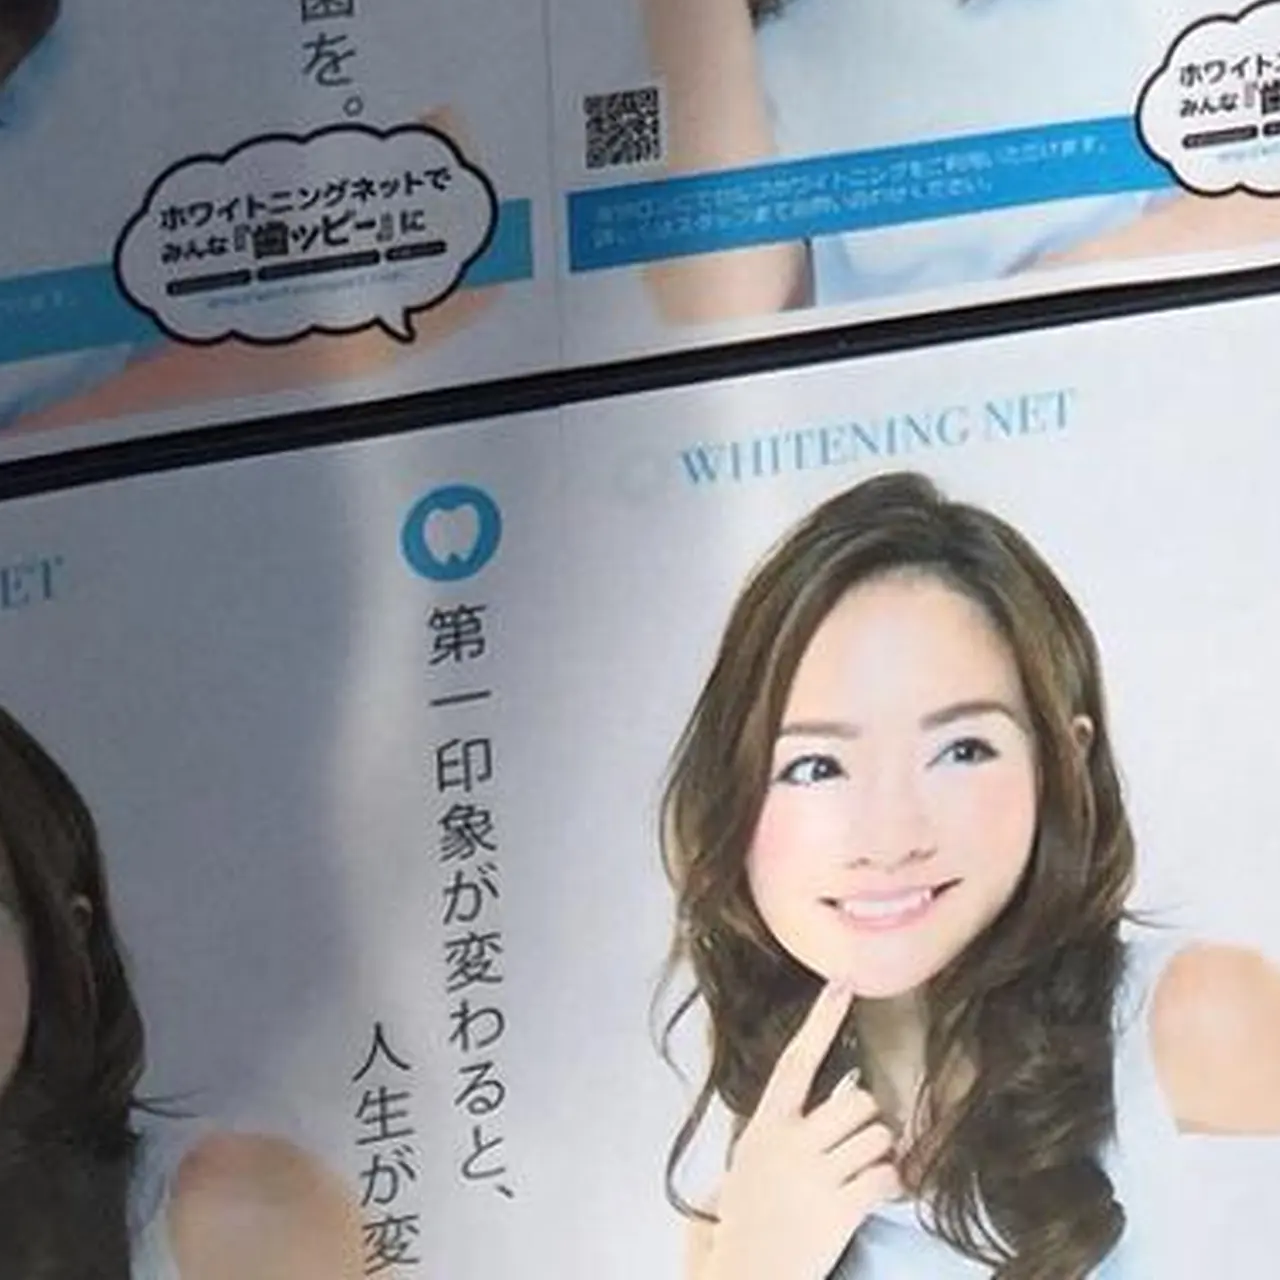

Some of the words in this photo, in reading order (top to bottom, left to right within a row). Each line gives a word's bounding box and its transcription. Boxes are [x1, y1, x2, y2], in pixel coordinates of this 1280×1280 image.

[160, 167, 451, 231] ホワイトニングネットで
[678, 399, 971, 487] WHITENING
[984, 386, 1078, 438] NET
[426, 603, 516, 1200] 第一印象が変わると、
[351, 1020, 421, 1277] 人生が変
